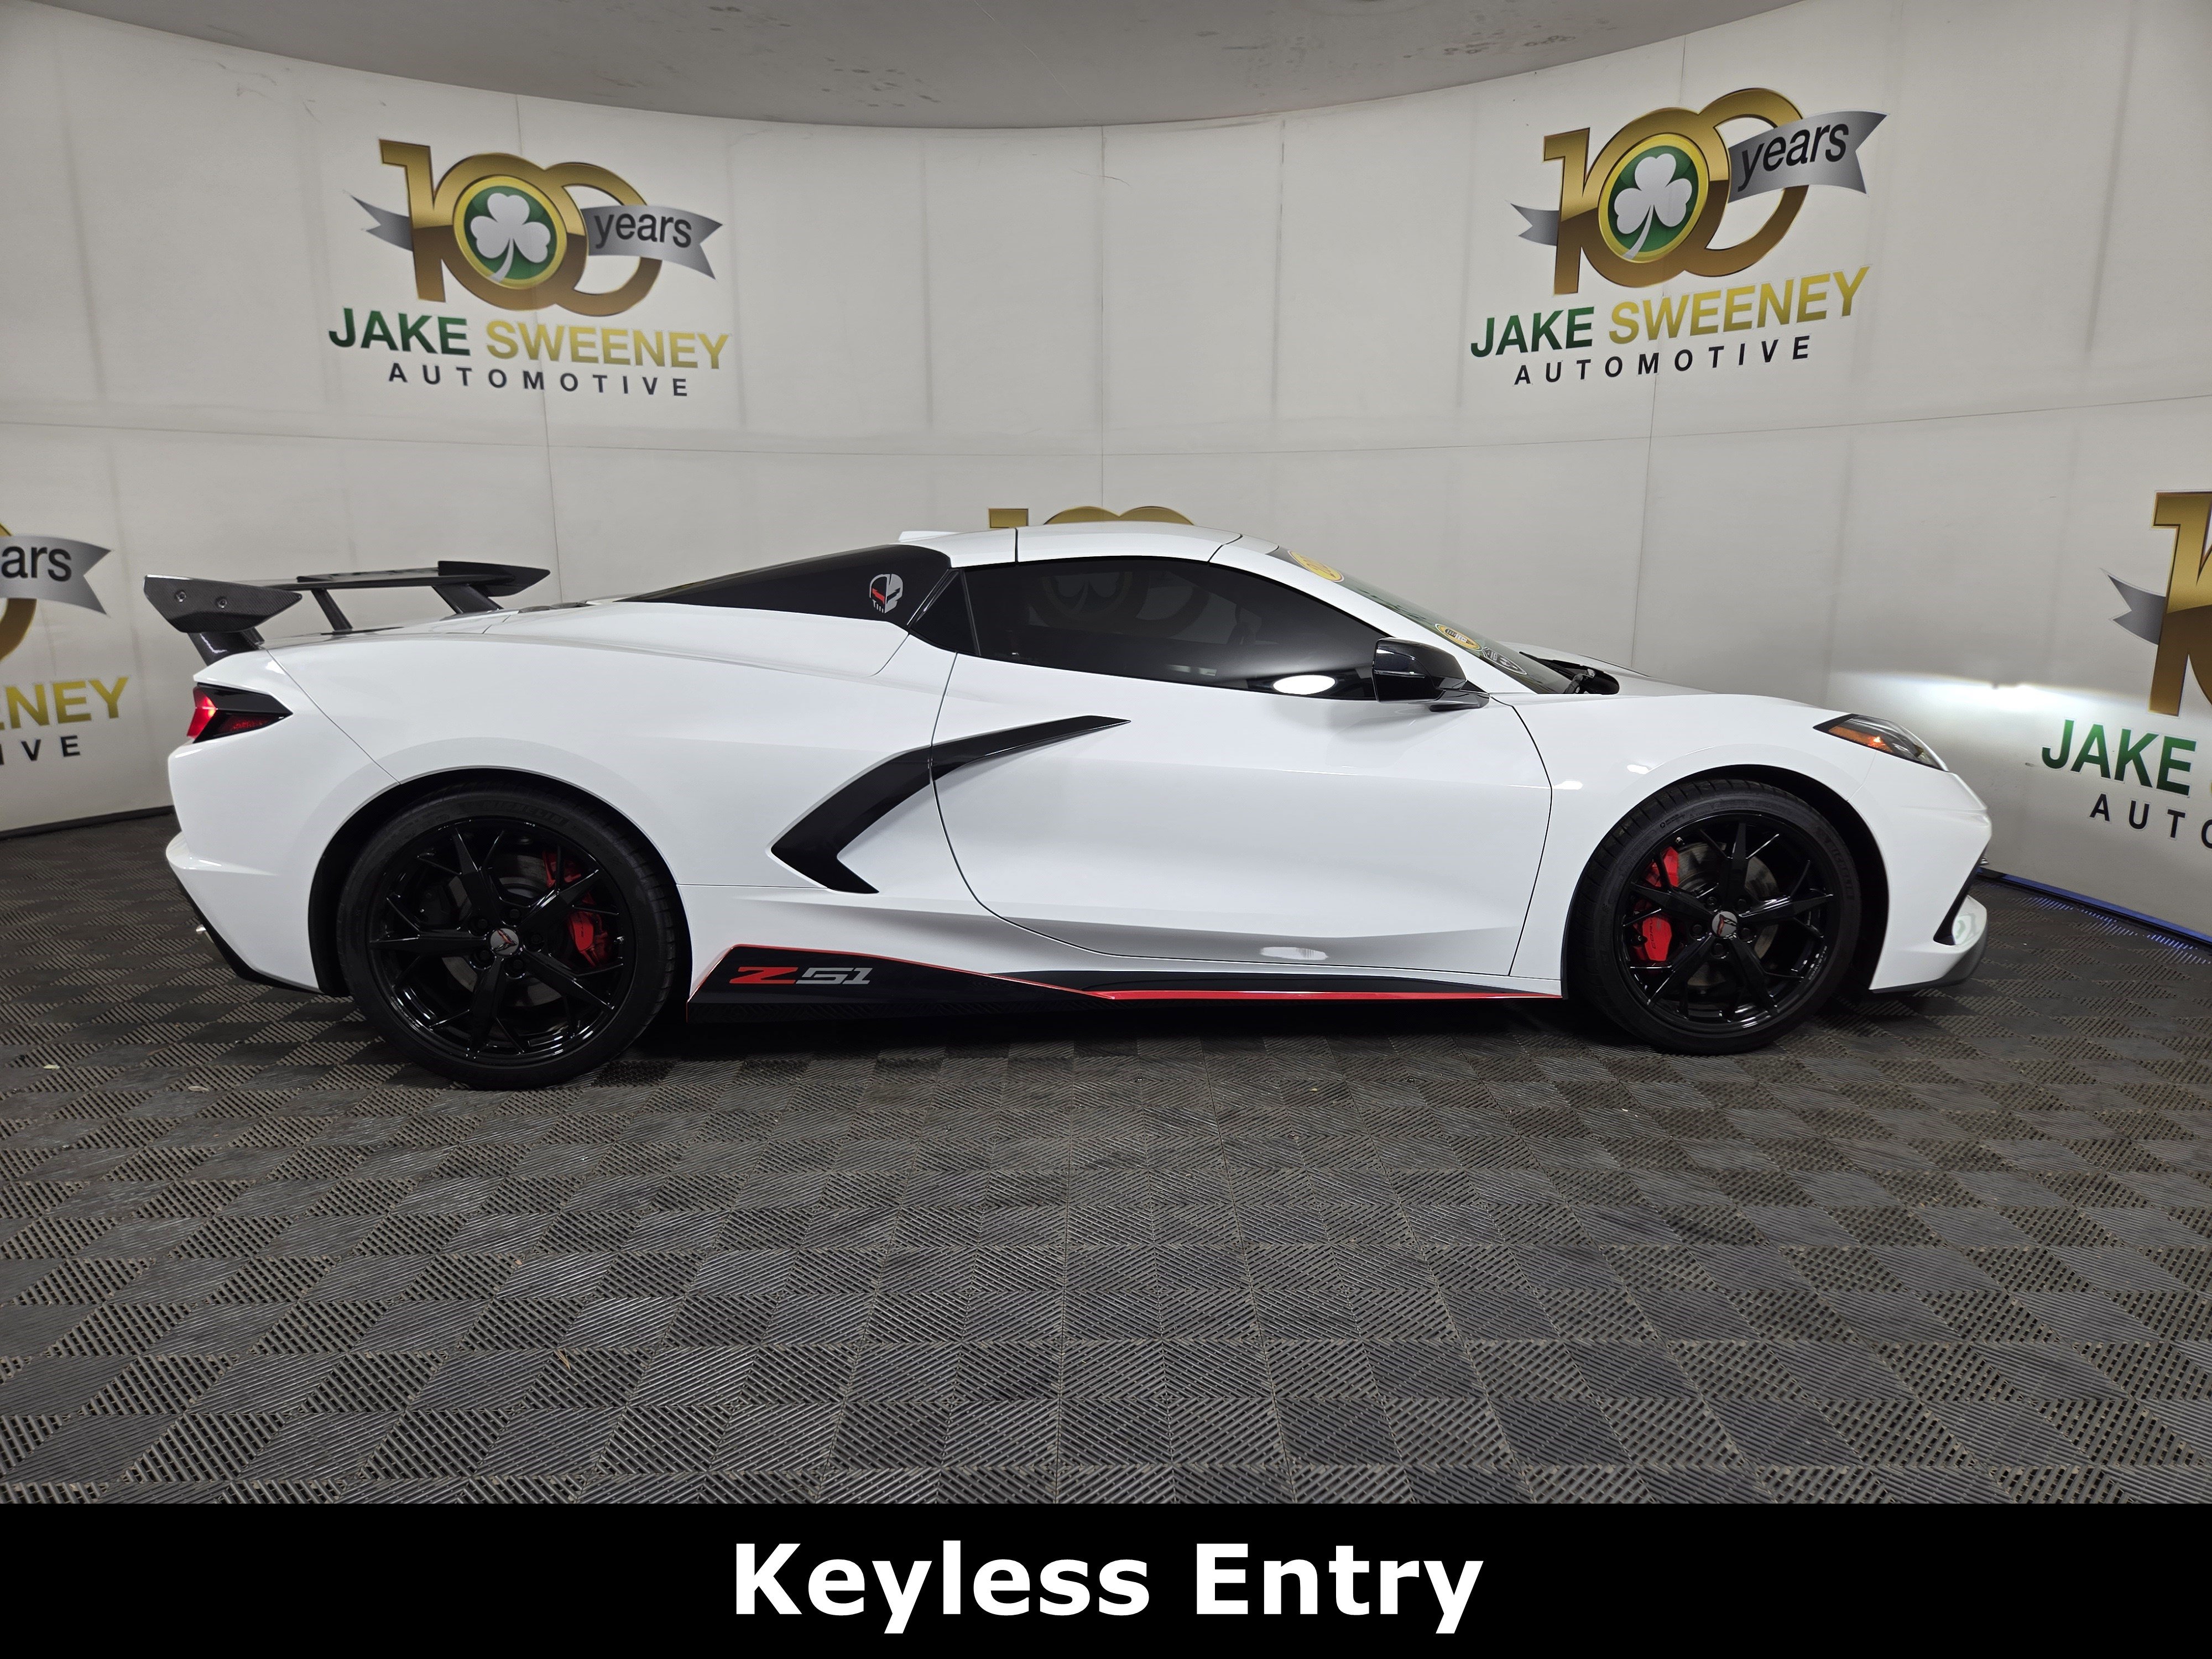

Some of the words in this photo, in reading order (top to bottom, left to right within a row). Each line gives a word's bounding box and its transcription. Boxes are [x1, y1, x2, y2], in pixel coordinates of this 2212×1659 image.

[1738, 123, 1849, 192] years
[593, 212, 692, 248] years
[329, 308, 471, 356] JAKE
[486, 320, 729, 369] SWEENEY
[1470, 307, 1595, 357] JAKE
[1609, 266, 1870, 344] SWEENEY
[389, 363, 687, 397] AUTOMOTIVE
[1514, 336, 1810, 385] AUTOMOTIVE
[0, 677, 129, 731] NEY
[2042, 719, 2197, 796] JAKE
[729, 967, 873, 984] Z51
